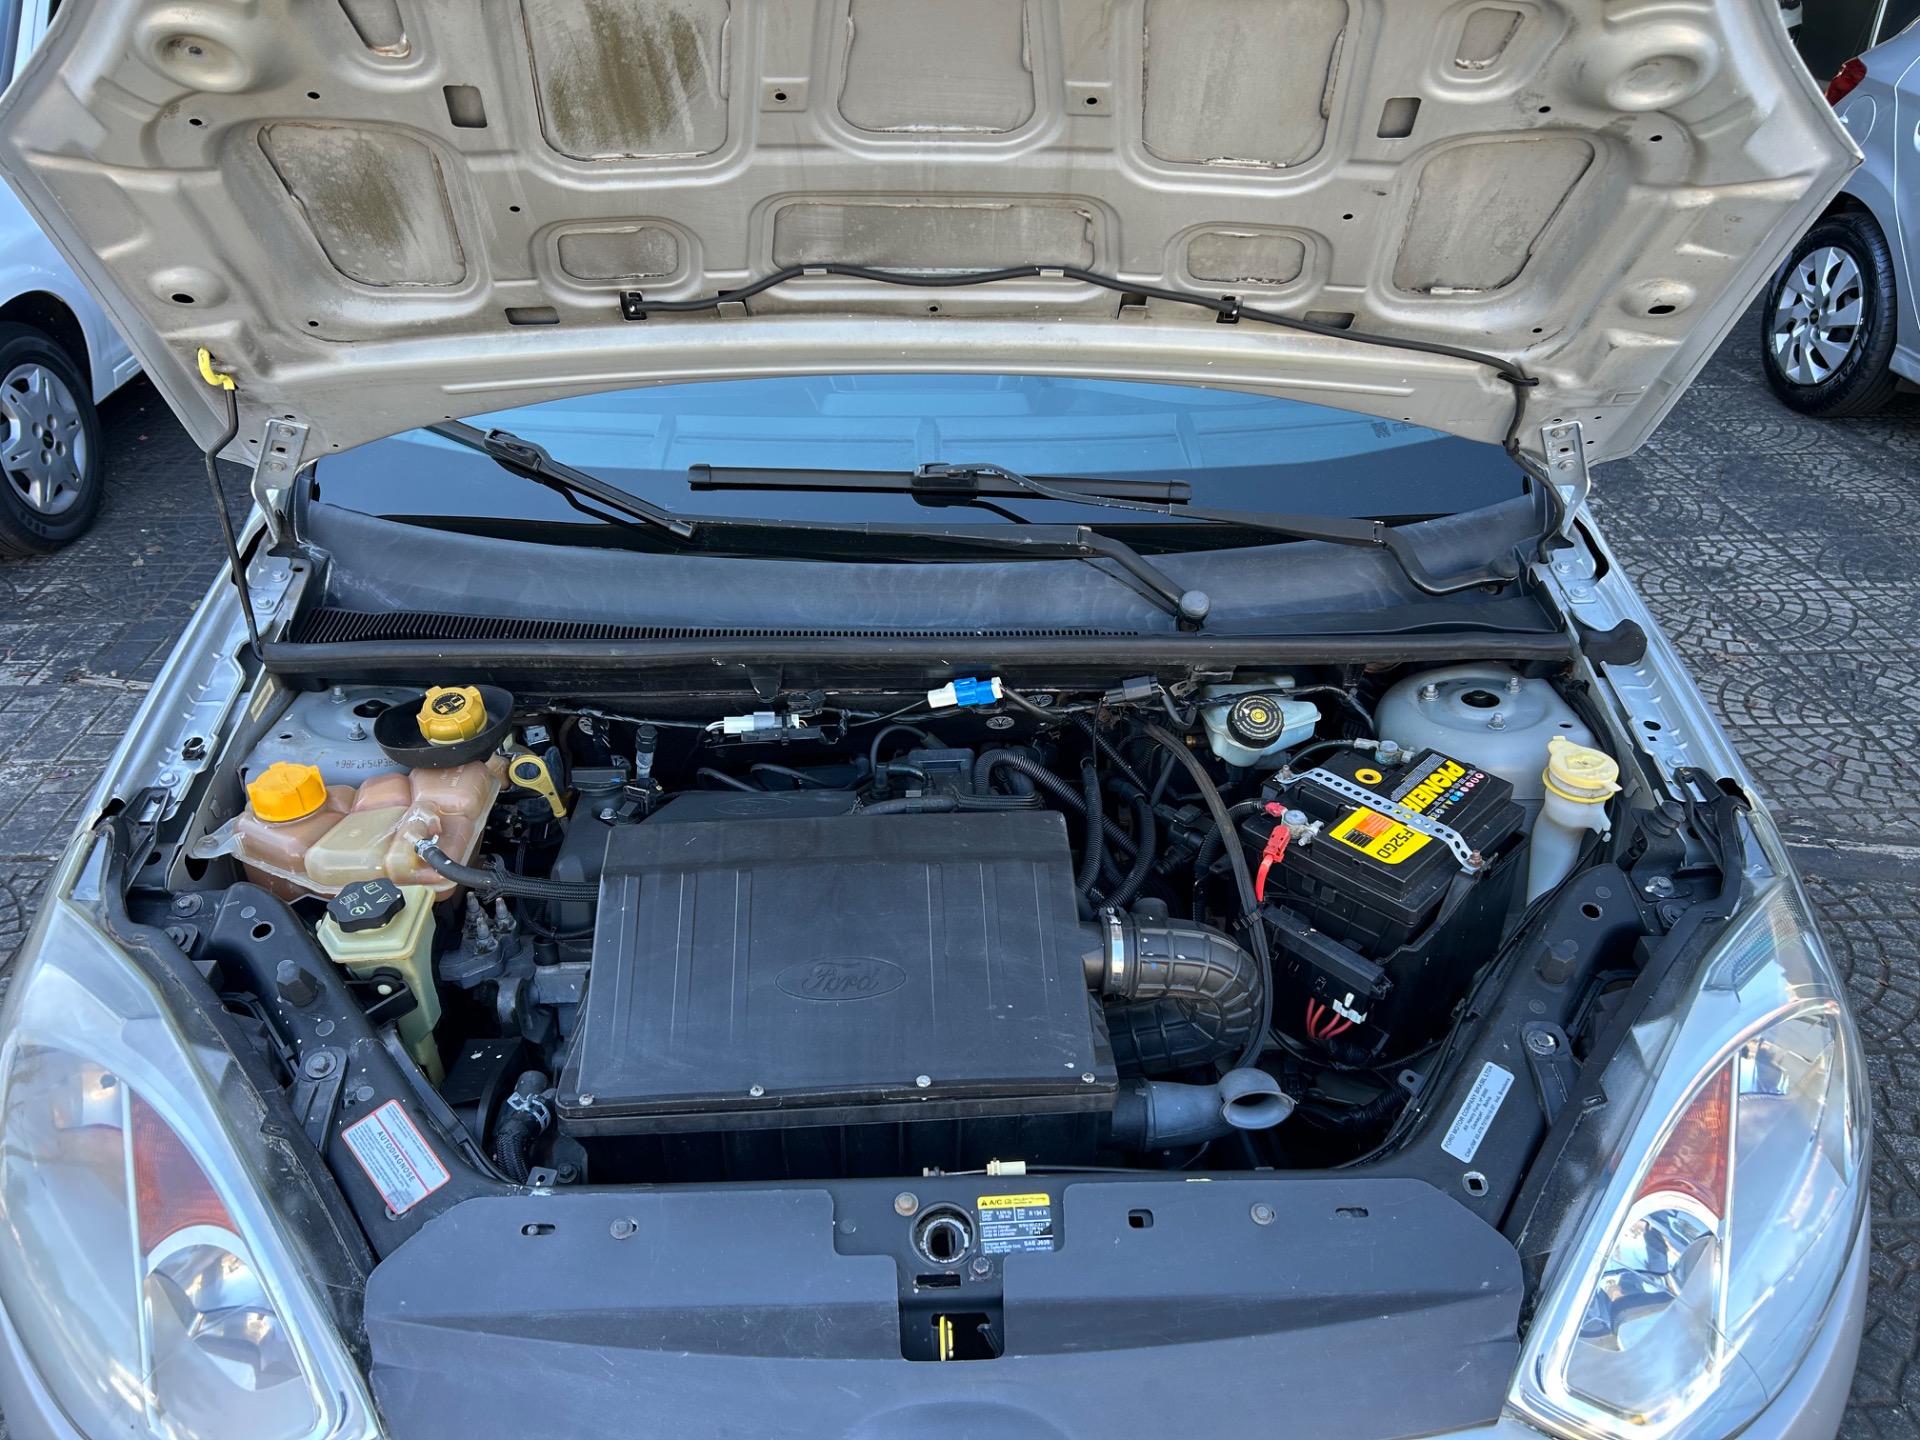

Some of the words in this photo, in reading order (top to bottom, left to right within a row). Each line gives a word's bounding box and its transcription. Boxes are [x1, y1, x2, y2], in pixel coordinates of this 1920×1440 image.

[1376, 828, 1414, 859] F52GD
[801, 961, 880, 993] Ford
[1444, 1132, 1454, 1148] FORD
[1453, 1117, 1464, 1134] MOTOR
[1462, 1094, 1477, 1116] COMPANY
[1474, 1078, 1487, 1094] BRASIL
[377, 1131, 415, 1182] AUTODIAGNOSE
